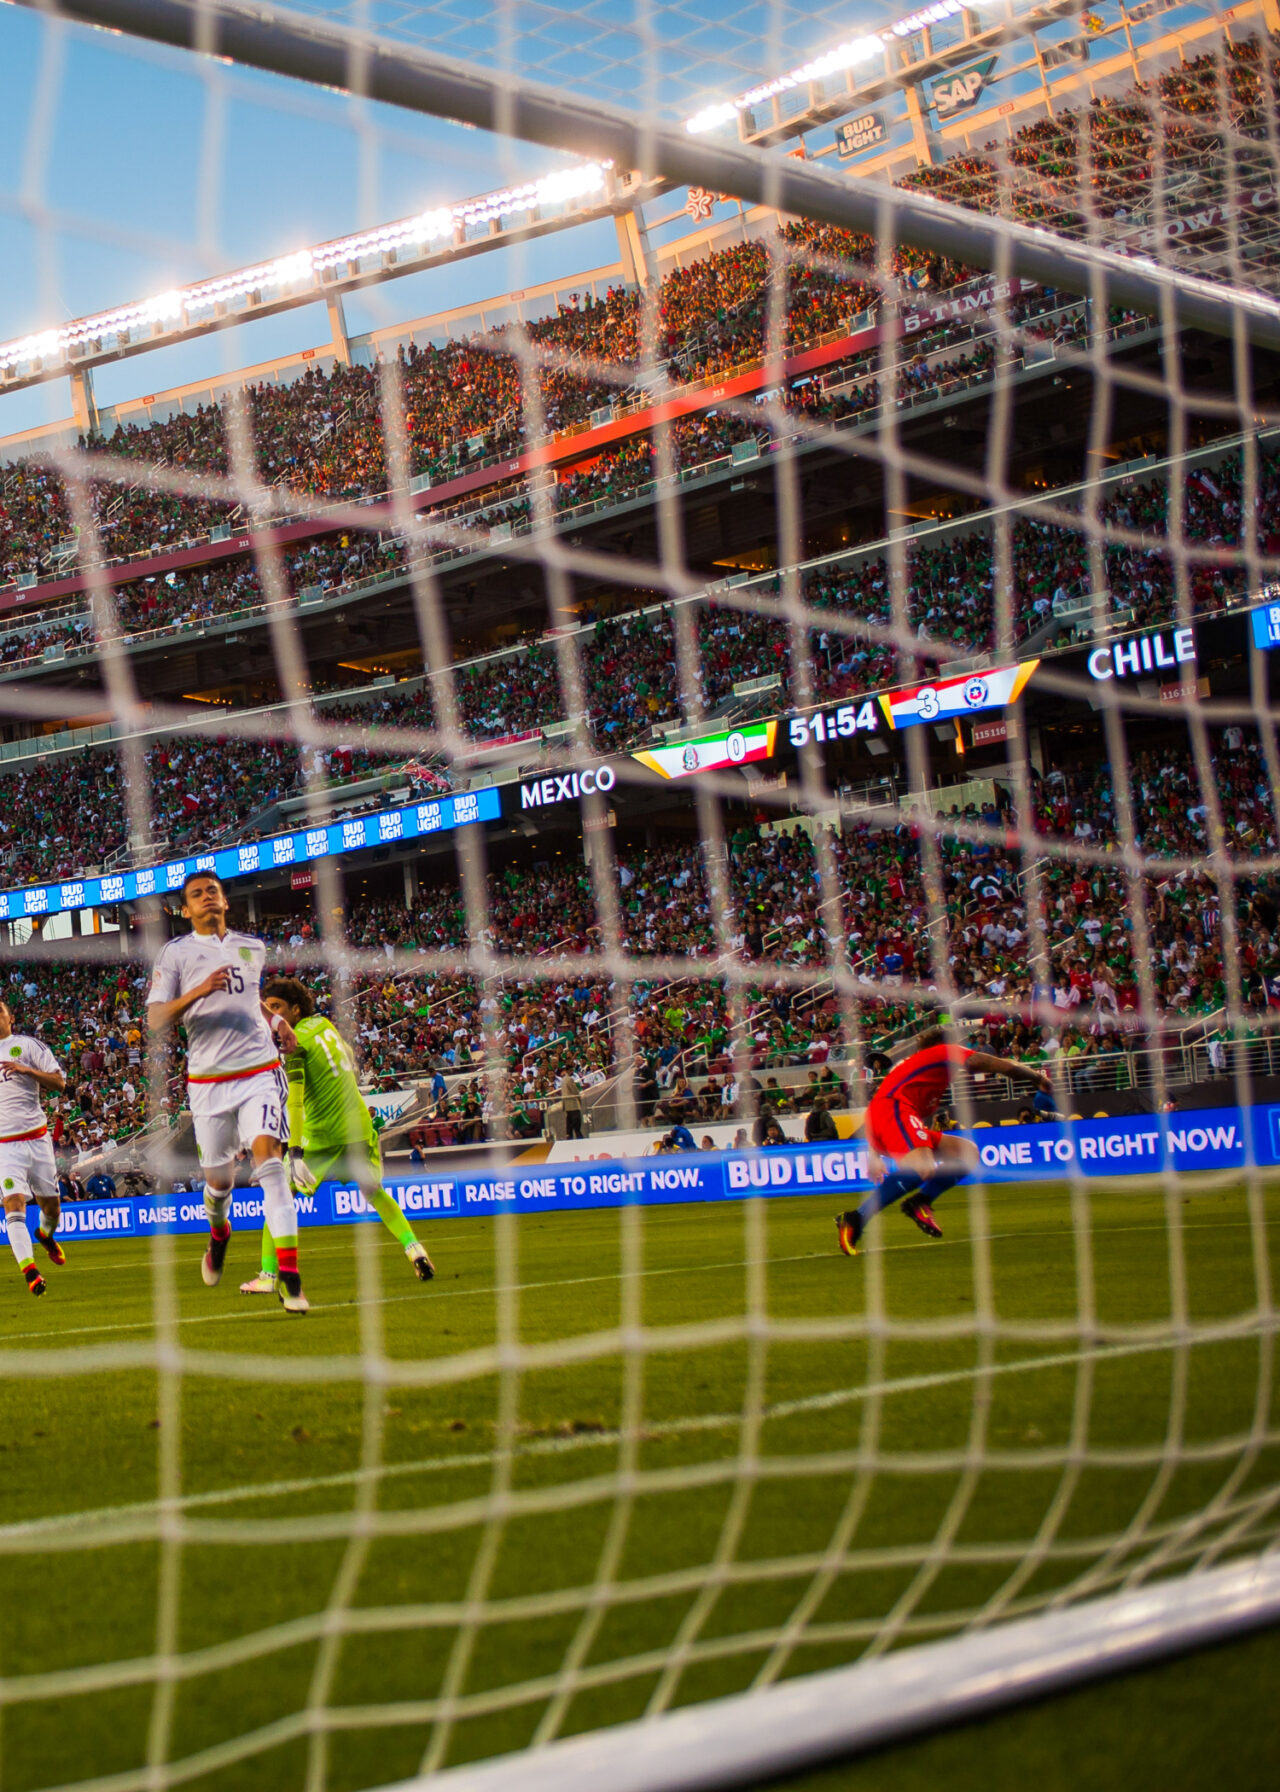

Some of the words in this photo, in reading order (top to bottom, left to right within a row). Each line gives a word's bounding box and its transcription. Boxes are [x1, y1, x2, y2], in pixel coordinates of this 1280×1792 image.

[934, 71, 982, 113] SAP
[843, 115, 875, 138] BUD
[839, 125, 883, 155] LIGHT
[903, 278, 1011, 334] 5-TIME
[1088, 627, 1197, 681] CHILE
[916, 687, 940, 720] 3
[789, 701, 877, 747] 51:54
[726, 732, 746, 762] 0
[520, 765, 616, 809] MEXICO
[454, 794, 476, 810] BUD
[418, 803, 439, 819] BUD
[453, 806, 479, 823] LIGHT
[343, 821, 364, 836] BUD
[417, 814, 441, 831] LIGHT
[274, 837, 293, 852] BUD
[307, 830, 327, 844] BUD
[343, 832, 366, 848] LIGHT
[239, 846, 258, 860] BUD
[273, 848, 295, 863] LIGHT
[306, 841, 329, 856] LIGHT
[167, 863, 185, 876] BUD
[196, 856, 215, 870] BUD
[238, 856, 259, 871] LIGHT
[101, 877, 124, 890] BUD
[136, 870, 153, 883] BUD
[25, 889, 46, 902] BUD
[100, 887, 125, 901] LIGHT
[136, 880, 155, 894] LIGHT
[24, 899, 48, 913] LIGHT
[226, 967, 245, 995] 15
[314, 1028, 352, 1078] 13
[261, 1103, 280, 1130] 15
[981, 1142, 1032, 1167] ONE
[1038, 1139, 1074, 1162] TO
[1080, 1132, 1159, 1159] RIGHT
[1167, 1126, 1243, 1153] NOW.
[728, 1157, 792, 1188] BUD
[795, 1151, 869, 1184] LIGH
[465, 1182, 516, 1202] RAISE
[520, 1178, 556, 1198] ONE
[561, 1177, 586, 1195] TO
[589, 1173, 645, 1194] RIGHT
[650, 1168, 704, 1190] NOW.
[233, 1200, 265, 1218] RIGH
[294, 1197, 318, 1214] OW.
[335, 1190, 376, 1214] BU
[56, 1213, 77, 1233] UD
[79, 1207, 130, 1232] LIGHT
[139, 1206, 176, 1224] RAISE
[180, 1204, 207, 1220] ONE
